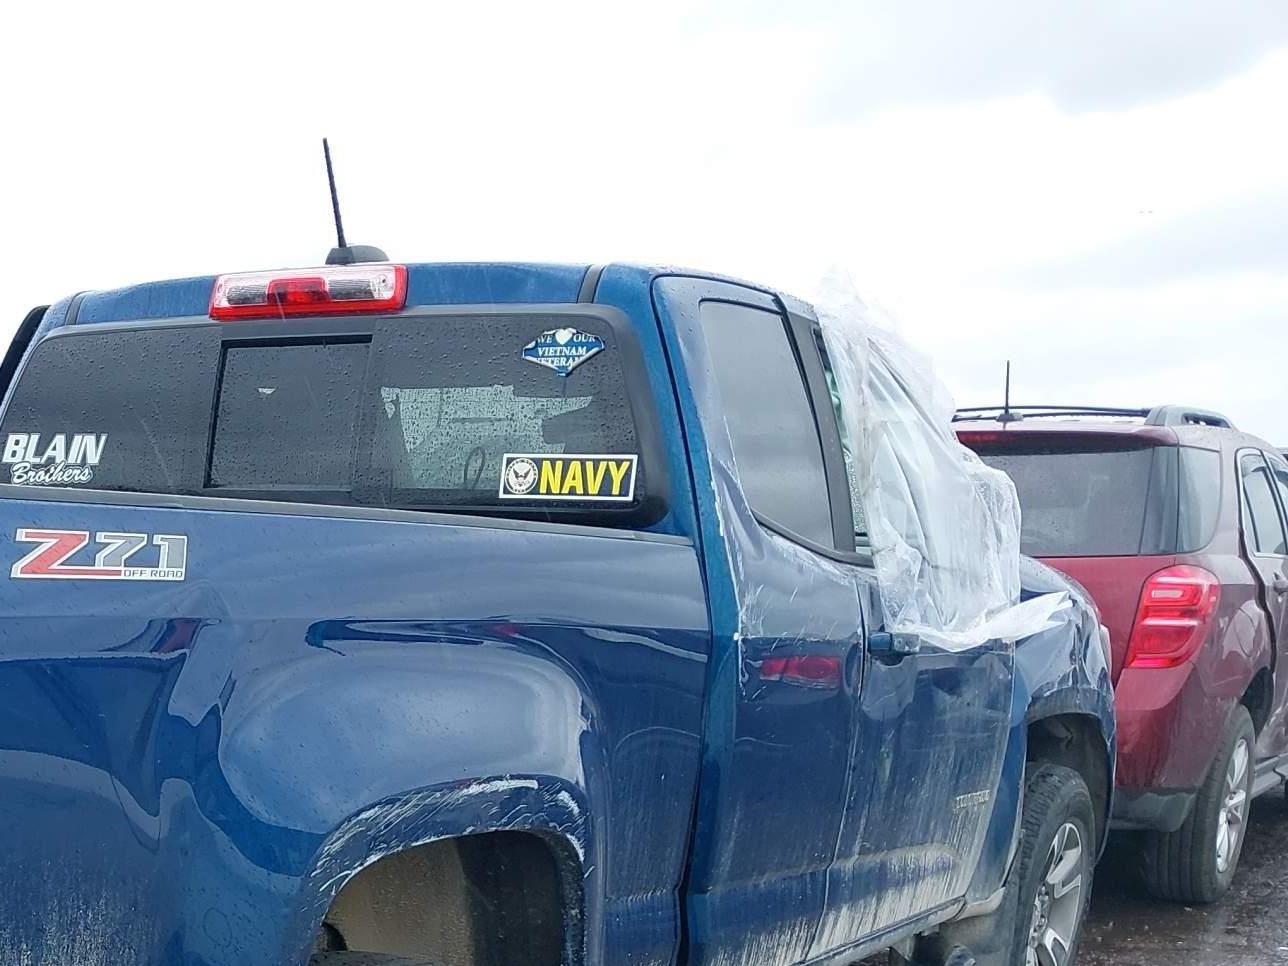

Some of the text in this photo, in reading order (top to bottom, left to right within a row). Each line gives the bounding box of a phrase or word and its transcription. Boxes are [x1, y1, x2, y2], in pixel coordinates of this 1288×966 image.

[538, 346, 587, 357] VIETNAM
[2, 433, 108, 465] BLAIN
[11, 460, 93, 485] Brothers
[539, 460, 630, 495] NAVY
[11, 528, 187, 580] Z71
[124, 569, 183, 579] OFF ROAD
